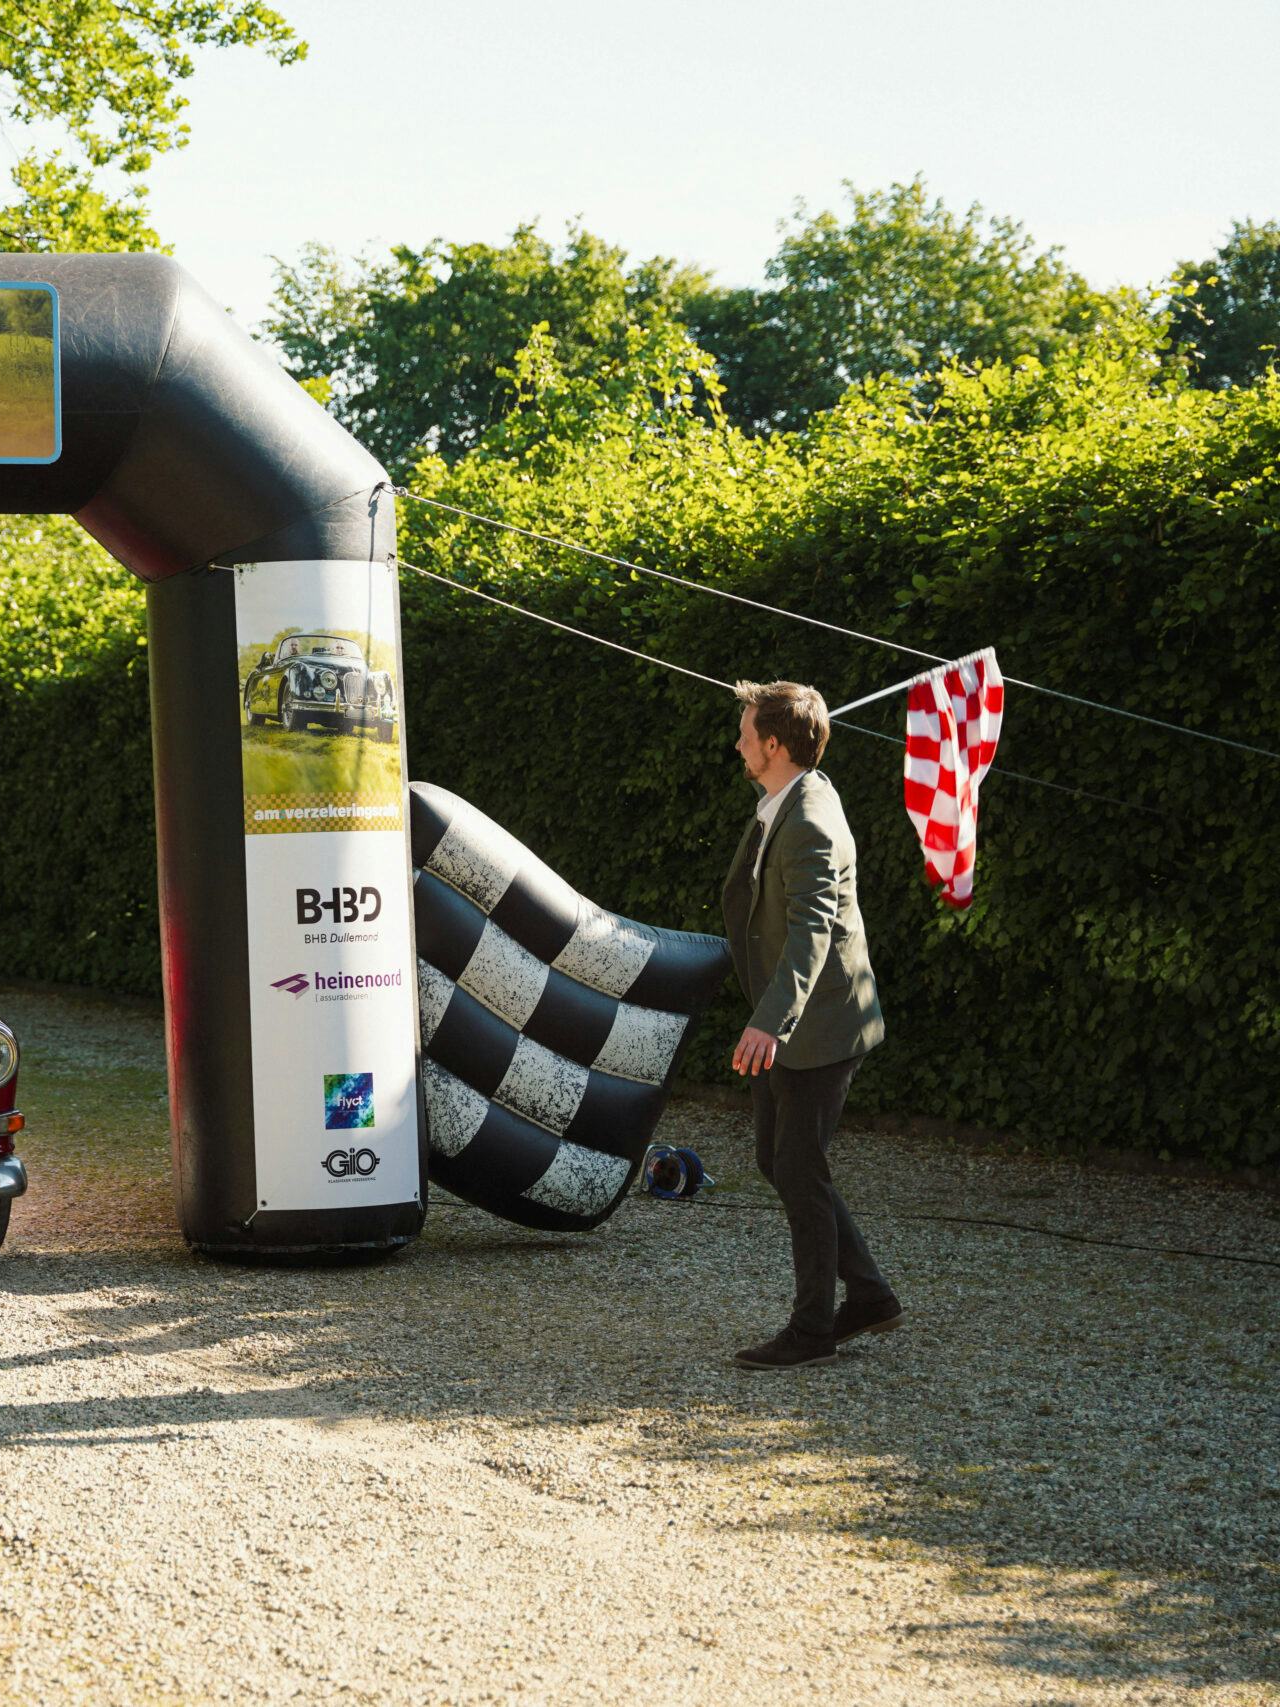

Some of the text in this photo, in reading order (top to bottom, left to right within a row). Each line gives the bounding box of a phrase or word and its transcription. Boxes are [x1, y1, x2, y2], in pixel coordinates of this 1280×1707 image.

[304, 932, 379, 944] BHB Dullemond
[315, 968, 402, 990] heinenoord
